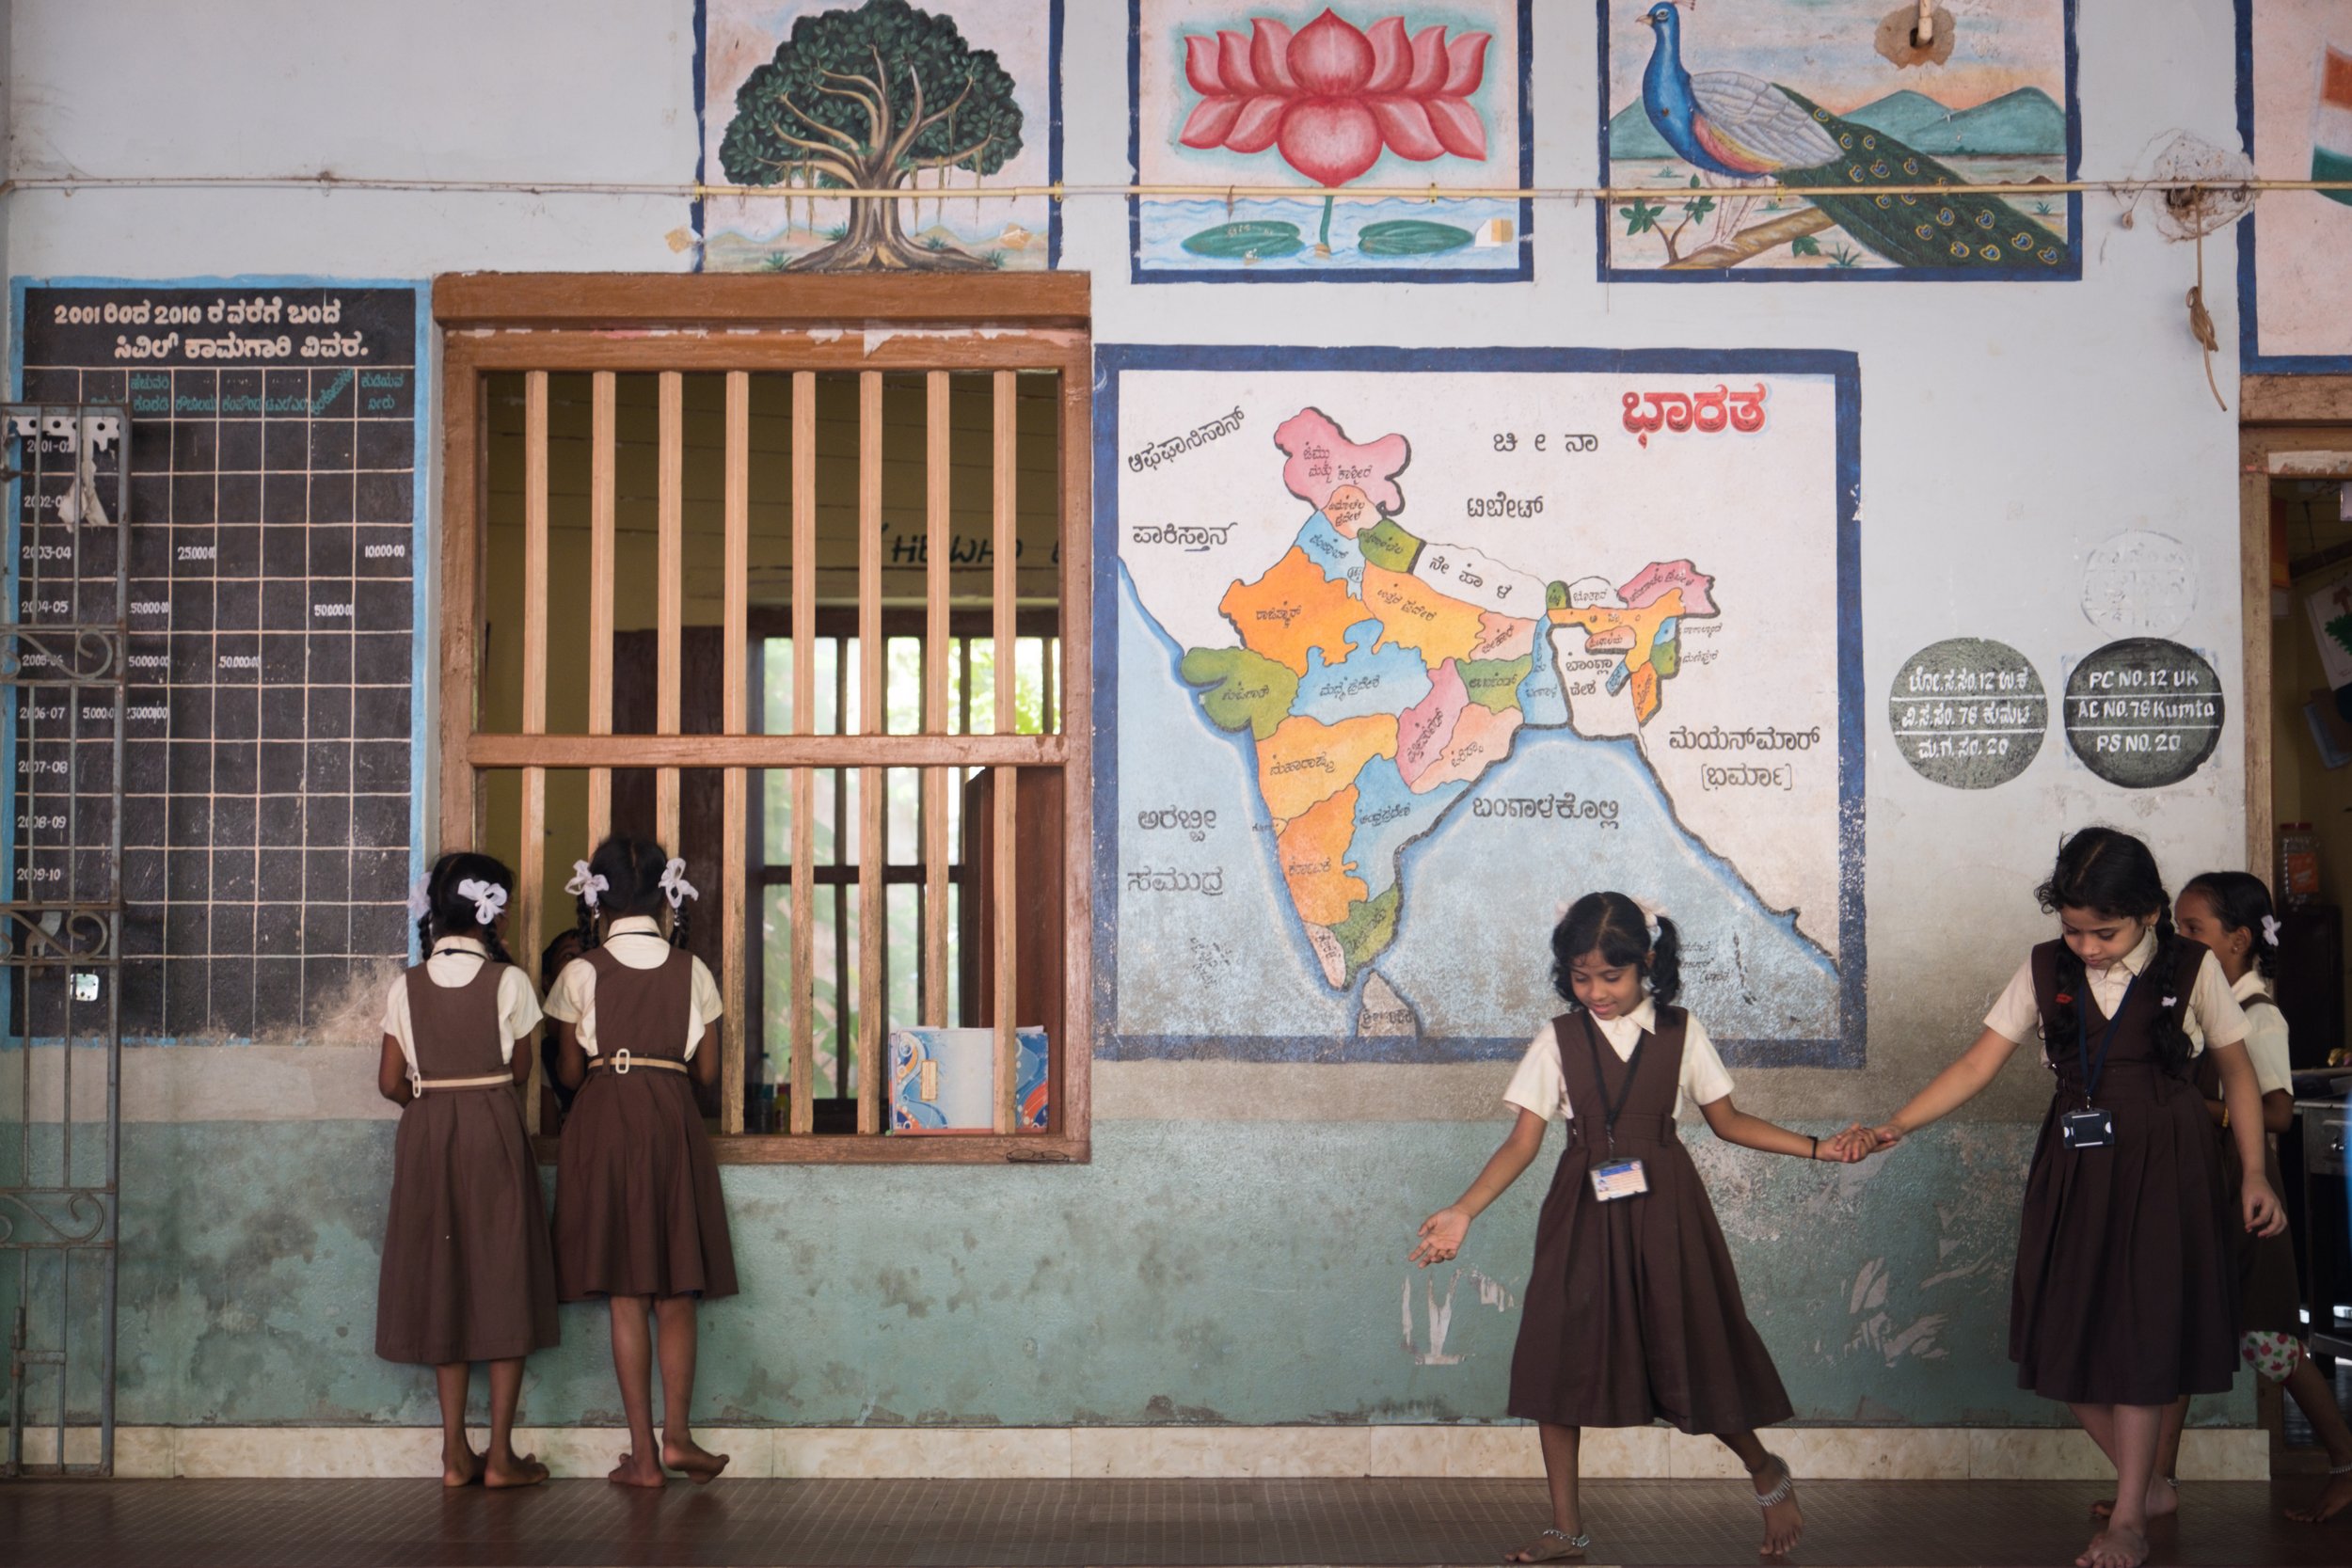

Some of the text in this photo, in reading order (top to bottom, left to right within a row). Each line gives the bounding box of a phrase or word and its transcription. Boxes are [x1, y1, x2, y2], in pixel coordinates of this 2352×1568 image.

[55, 304, 100, 325] 2001
[154, 304, 201, 325] 2010
[287, 298, 341, 325] ಬಂದ
[114, 330, 179, 358] ಸಿವಿಲ್
[184, 329, 292, 358] ಕಾಮಗಾರಿ
[1622, 383, 1768, 449] ಭಾರತ
[26, 439, 71, 452] 201-0
[1466, 491, 1544, 519] ಟಿಬೇಟ್
[2089, 671, 2115, 689] PC
[2173, 669, 2200, 688] UK
[20, 705, 65, 720] 206-07
[2077, 701, 2100, 719] AC
[2153, 699, 2216, 719] Kumta
[1986, 736, 2010, 756] 20
[2096, 734, 2122, 752] PS
[1127, 864, 1224, 896] ಸಮುದ್ರ
